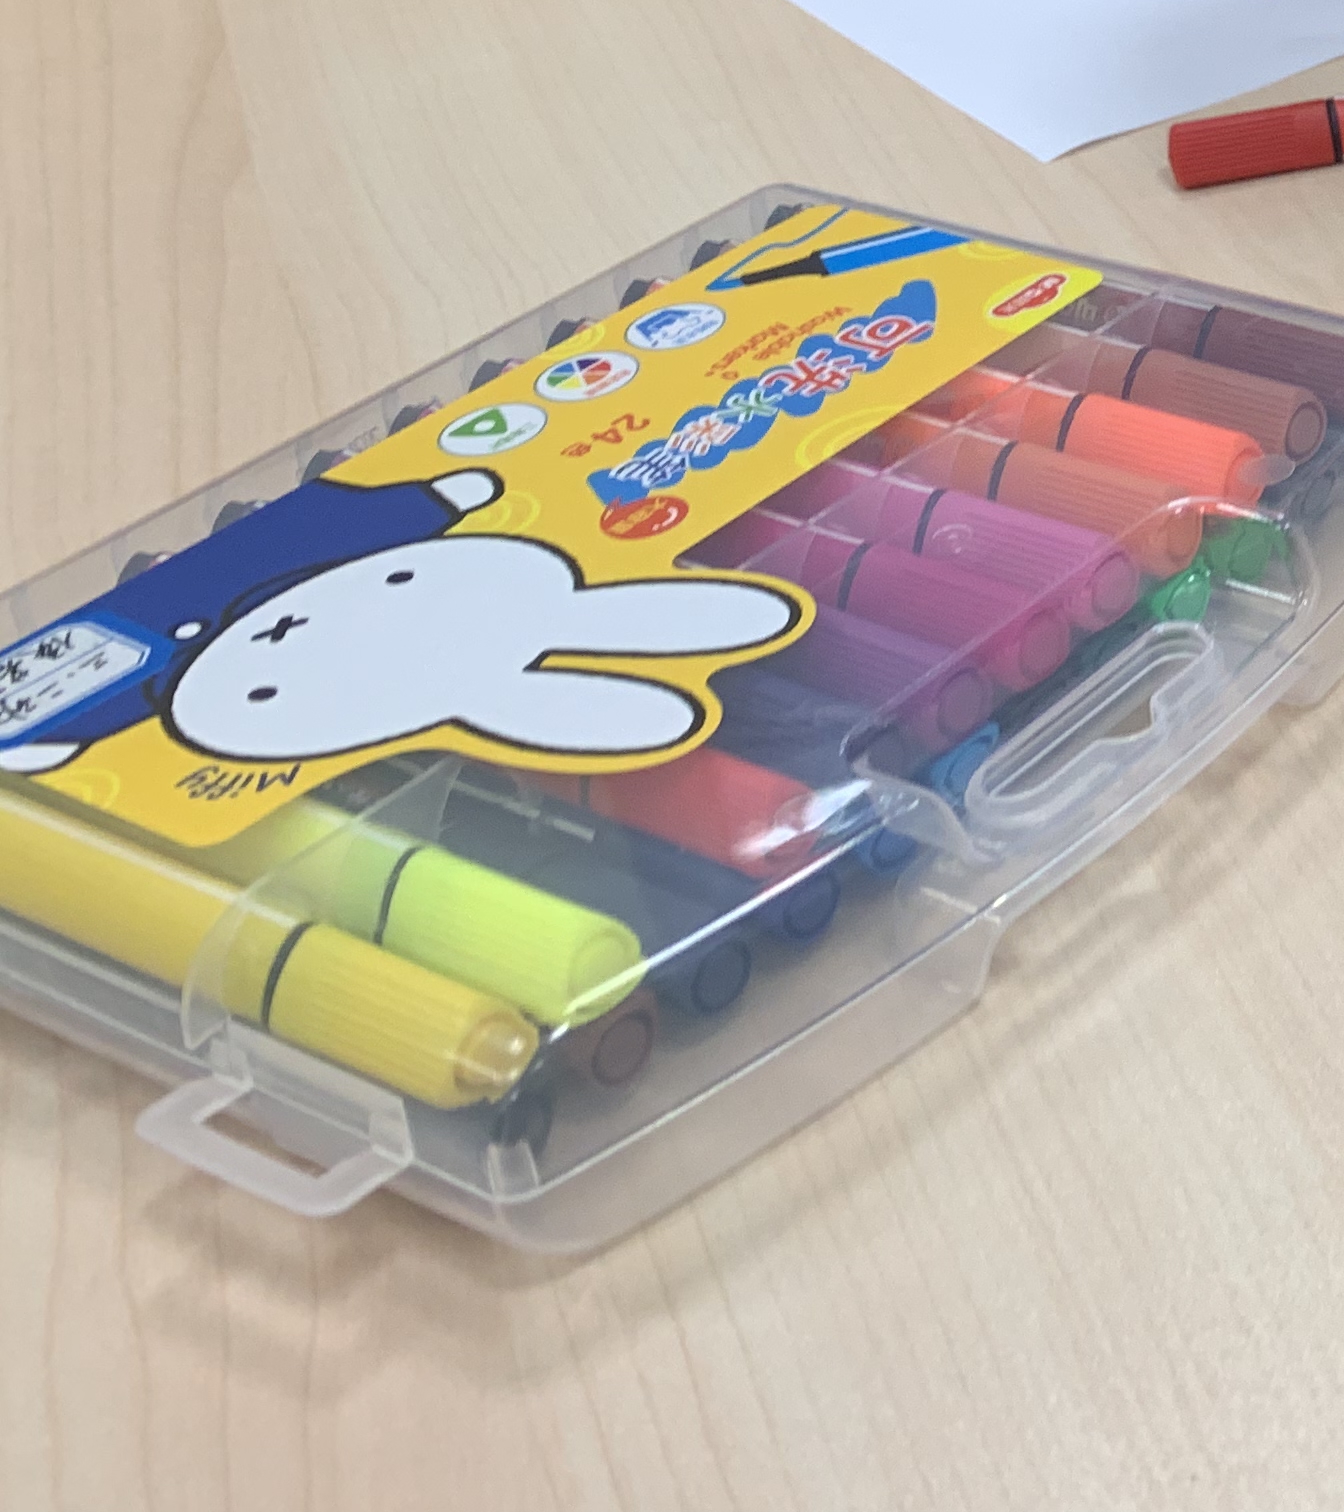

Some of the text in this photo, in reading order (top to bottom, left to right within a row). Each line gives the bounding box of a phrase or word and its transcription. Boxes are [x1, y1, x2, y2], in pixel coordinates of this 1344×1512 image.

[607, 314, 934, 489] 可洗水彩笔
[173, 763, 302, 801] Miffy
